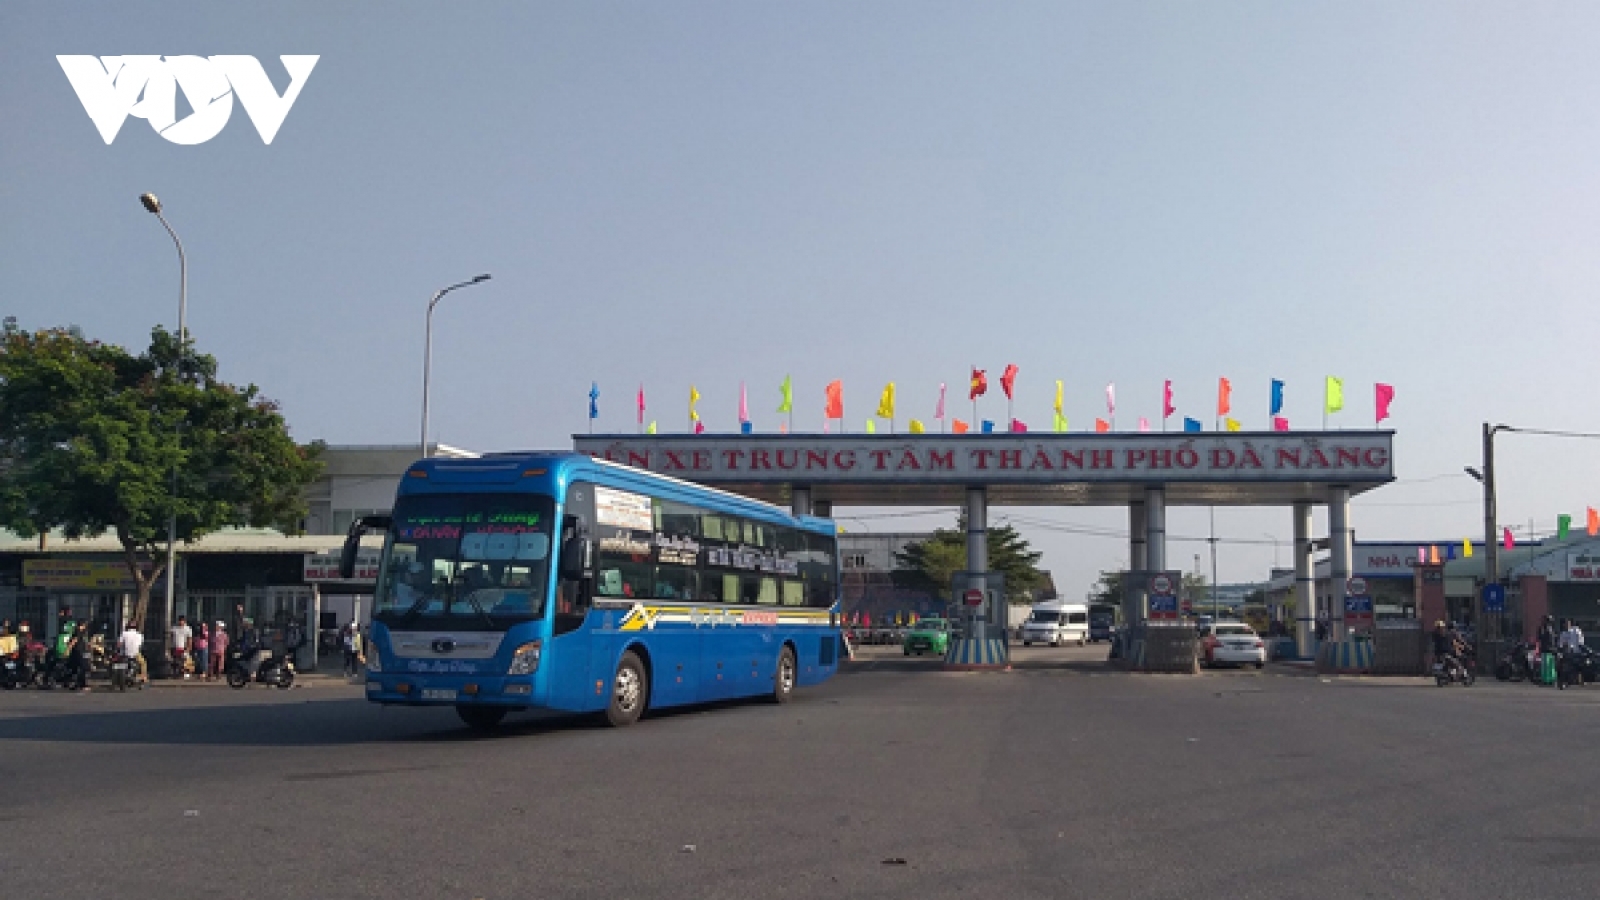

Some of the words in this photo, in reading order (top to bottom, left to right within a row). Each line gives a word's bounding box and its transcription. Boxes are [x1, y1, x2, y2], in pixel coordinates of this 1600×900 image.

[664, 447, 713, 470] XE
[721, 448, 857, 470] TRUNG
[869, 444, 956, 470] TÂM
[970, 443, 1115, 470] THÀNH
[1124, 439, 1200, 470] PHỐ
[1208, 441, 1264, 470] ĐÀ
